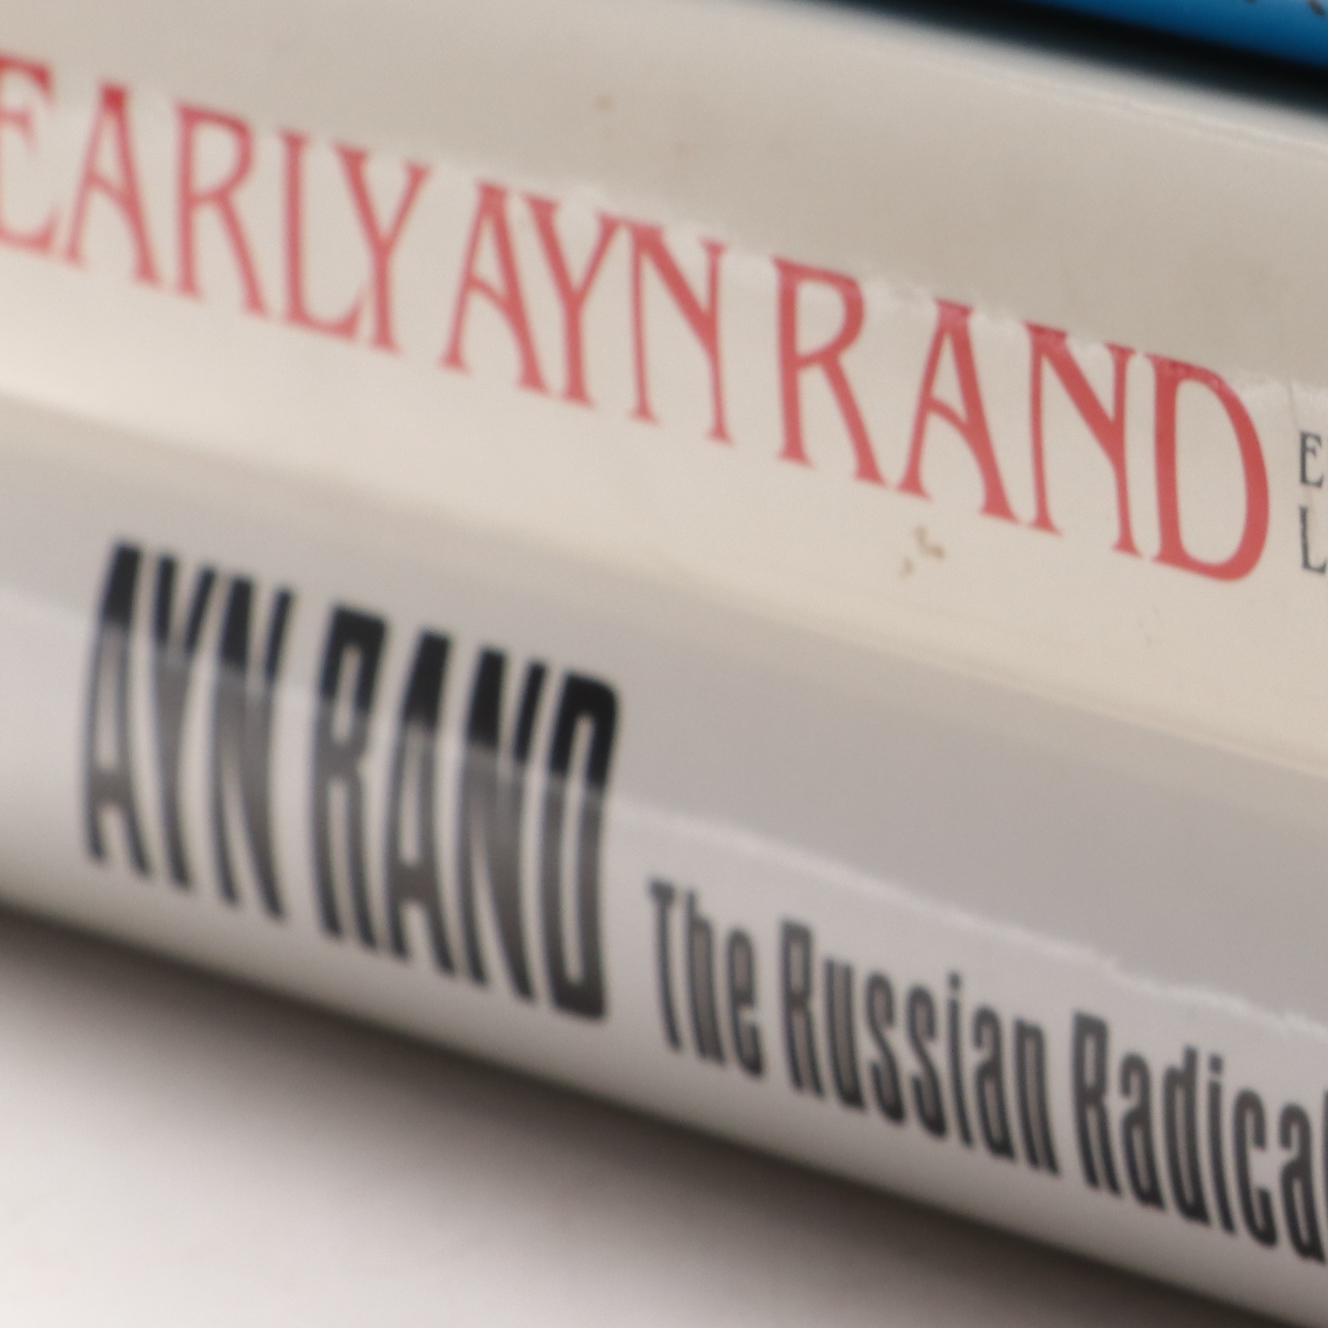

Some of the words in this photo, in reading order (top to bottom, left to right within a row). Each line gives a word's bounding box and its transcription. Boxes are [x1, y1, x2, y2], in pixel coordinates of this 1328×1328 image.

[0, 53, 432, 356] EARLY
[439, 180, 733, 445] AYN
[772, 259, 1270, 581] RAND
[82, 540, 295, 923] AYN
[306, 603, 620, 1021] RAND
[649, 880, 763, 1077] The
[779, 920, 1059, 1177] Russian
